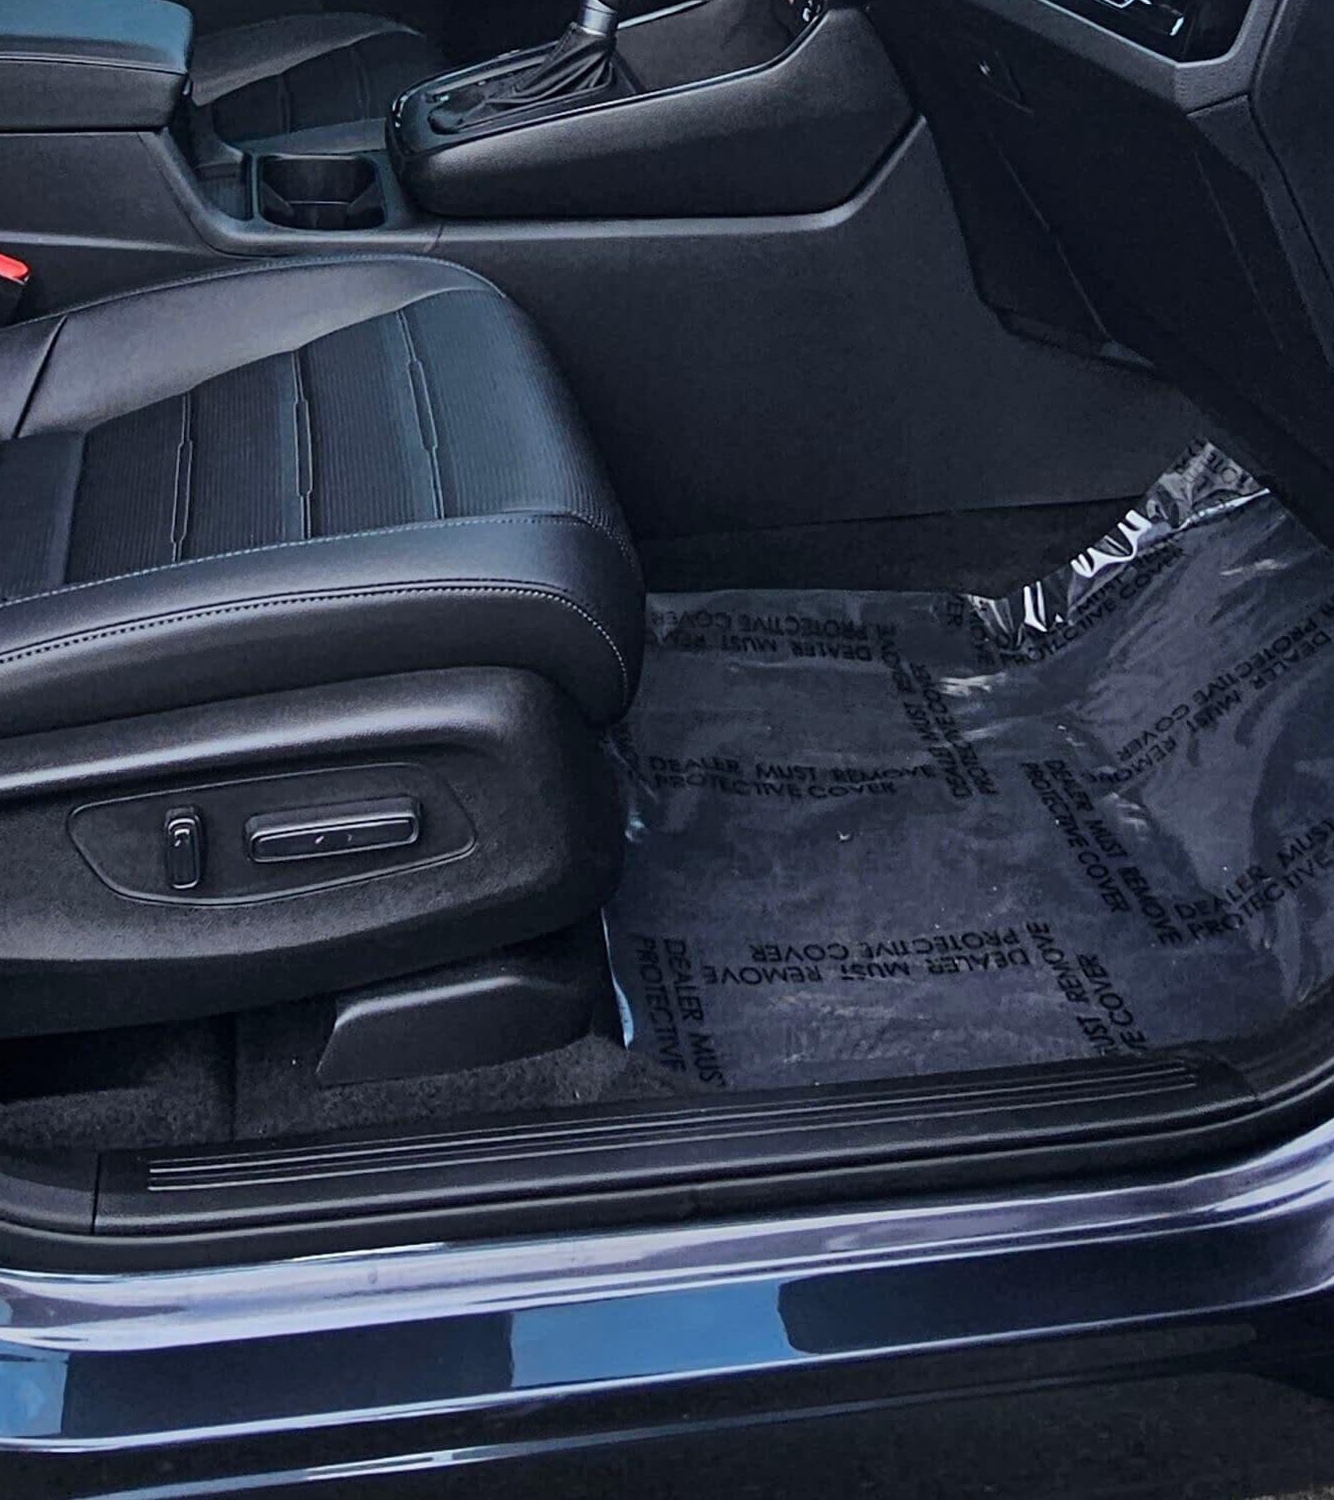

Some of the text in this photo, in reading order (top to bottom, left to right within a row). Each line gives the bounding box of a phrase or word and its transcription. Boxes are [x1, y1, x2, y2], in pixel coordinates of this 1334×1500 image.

[720, 635, 777, 653] MUST
[738, 613, 872, 641] PROTECTIVE
[789, 639, 873, 663] DEALER
[1119, 617, 1318, 762] PROTECTIVE COVER
[1250, 630, 1331, 690] DEALER
[1186, 690, 1242, 733] MUST
[648, 755, 740, 772] DEALER
[755, 763, 818, 782] MUST
[654, 772, 898, 799] PROTECTIVE COVER
[1020, 762, 1132, 913] PROTECTIVE COVER
[1044, 759, 1183, 945] DEALER MUST REMOVE
[1175, 862, 1269, 921] DEALER
[1187, 855, 1334, 940] PROTECTIVE
[703, 947, 1031, 986] DEALER MUST REMOVE
[748, 926, 1022, 964] PROTECTIVE COVER
[633, 933, 687, 1074] PROTECTIVE
[663, 937, 728, 1088] DEALER MUS
[1025, 921, 1116, 1052] UST REMOVE
[1077, 953, 1134, 1028] COVER
